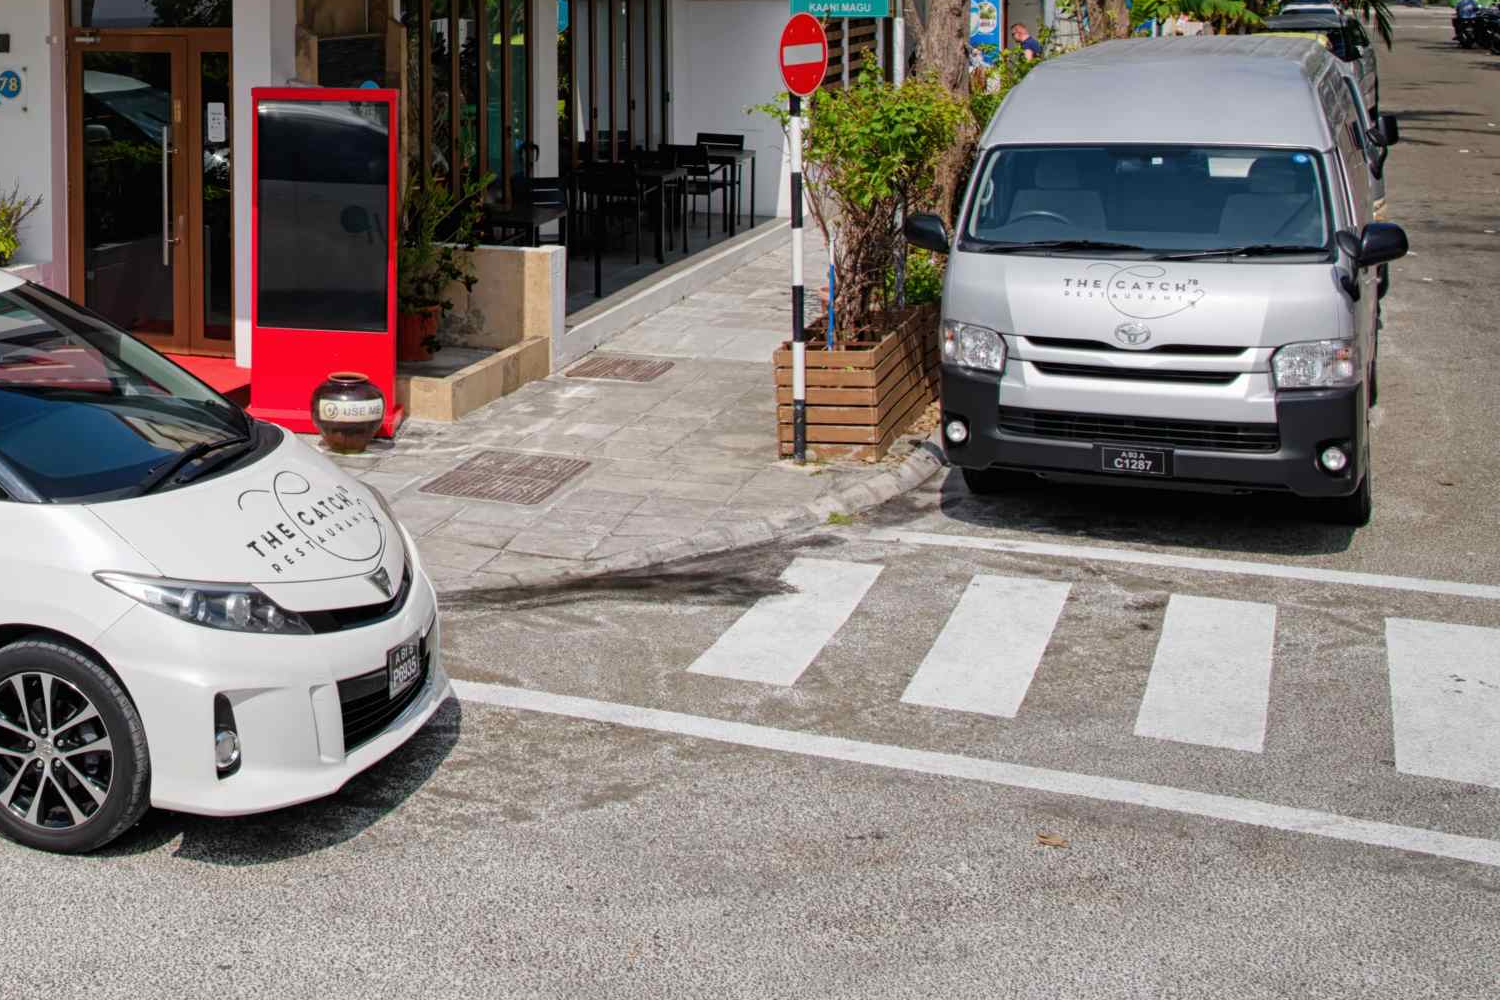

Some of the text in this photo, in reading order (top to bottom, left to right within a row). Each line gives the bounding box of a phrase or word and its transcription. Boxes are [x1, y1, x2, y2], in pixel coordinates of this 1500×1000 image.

[809, 2, 871, 12] KAANI MAGU
[1063, 278, 1102, 288] THE
[1115, 280, 1187, 292] CATCH
[343, 407, 366, 417] USE
[1113, 458, 1153, 470] C1287
[246, 522, 297, 557] THE
[296, 492, 354, 526] CATCH
[271, 512, 367, 574] RESTAURANT
